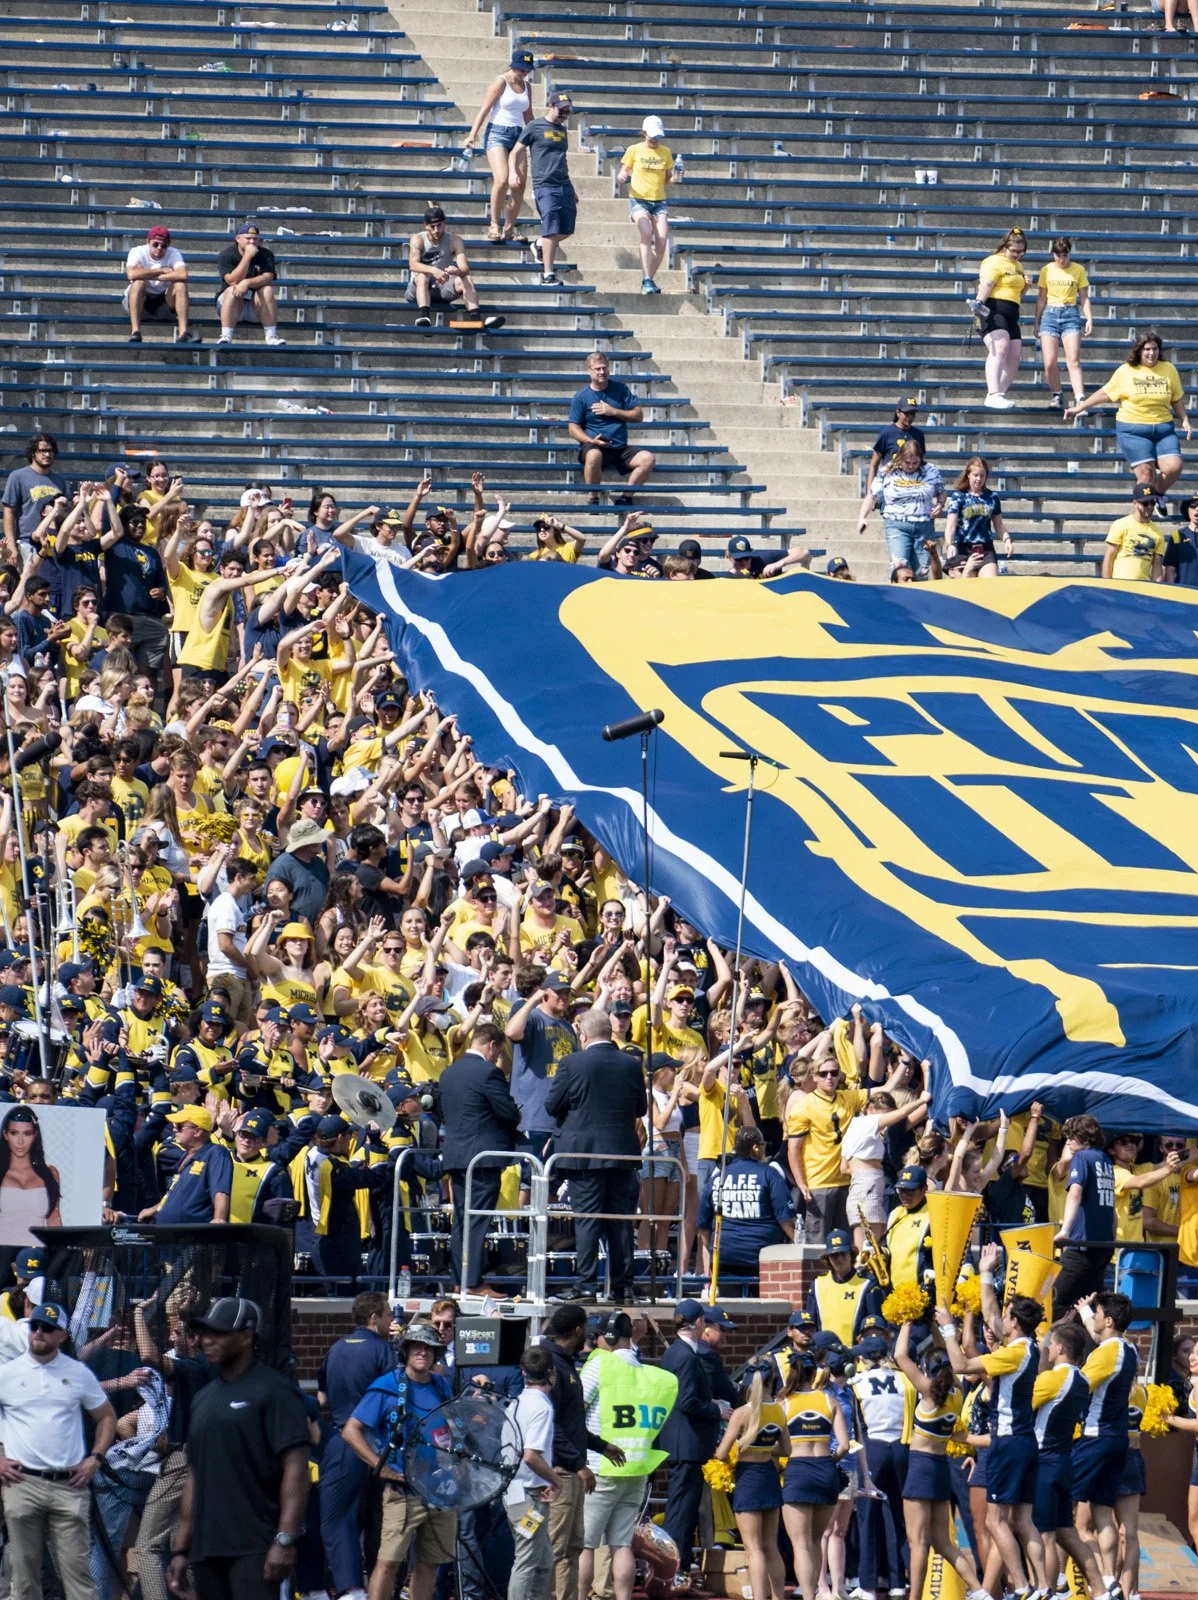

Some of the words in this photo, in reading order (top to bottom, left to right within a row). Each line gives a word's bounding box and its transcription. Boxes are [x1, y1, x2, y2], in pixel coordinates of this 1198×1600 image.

[850, 773, 1198, 877] IT
[712, 1173, 762, 1191] S.A.F.E.
[870, 1374, 899, 1397] M
